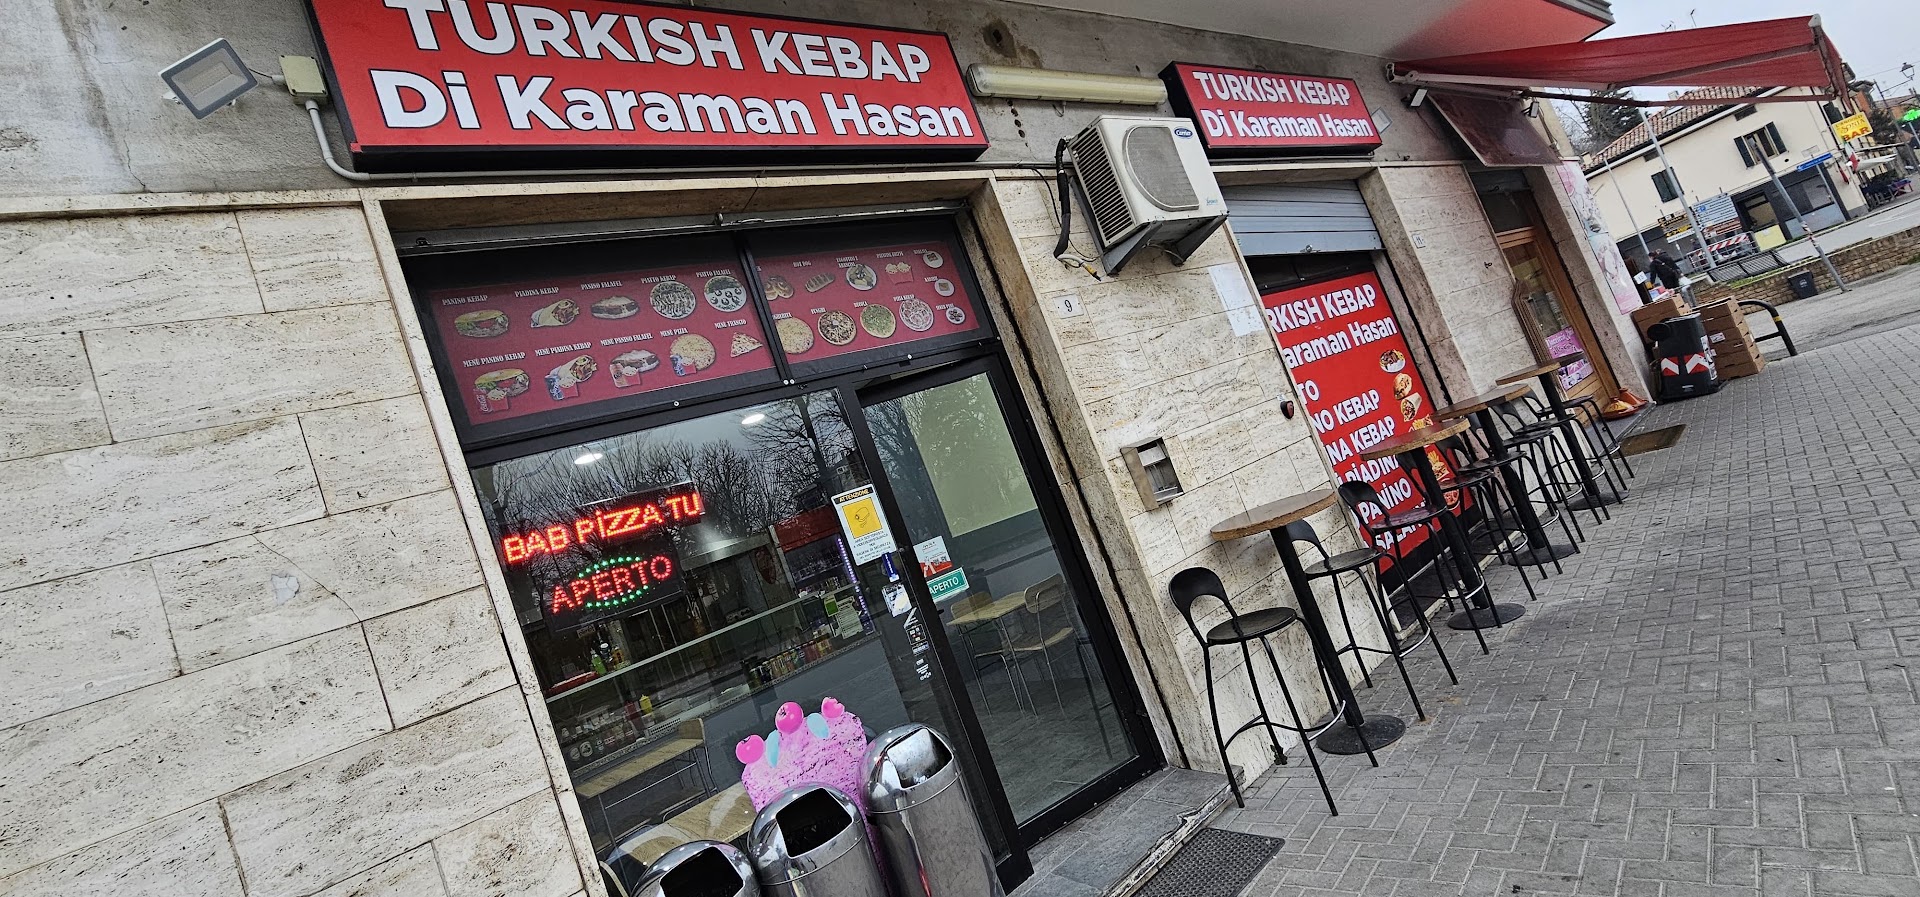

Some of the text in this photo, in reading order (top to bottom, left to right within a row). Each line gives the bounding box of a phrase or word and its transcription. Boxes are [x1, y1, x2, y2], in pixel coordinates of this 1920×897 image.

[384, 0, 931, 84] TURKISH KEBAP
[369, 69, 974, 138] Di Karaman Hasan
[1192, 71, 1351, 106] TURKISH KEBAP
[1200, 109, 1374, 137] Di Karaman Hasan
[1841, 127, 1870, 141] BAR
[442, 295, 488, 306] PANINO KEBAP
[514, 287, 560, 297] PIADINA KEBAP
[1064, 299, 1073, 313] 9
[1320, 284, 1376, 319] KEBAP
[573, 341, 592, 351] KEBAP
[1282, 316, 1398, 369] araman Hasan
[481, 356, 504, 365] PANINO
[505, 352, 526, 362] KEBAP
[1333, 389, 1380, 425] KEBAP
[1349, 415, 1395, 453] KEBAP
[839, 488, 870, 502] ATTENZIONE
[503, 523, 571, 564] BAB
[666, 492, 701, 520] TU
[551, 555, 673, 614] APERTO
[930, 576, 959, 594] APERTO
